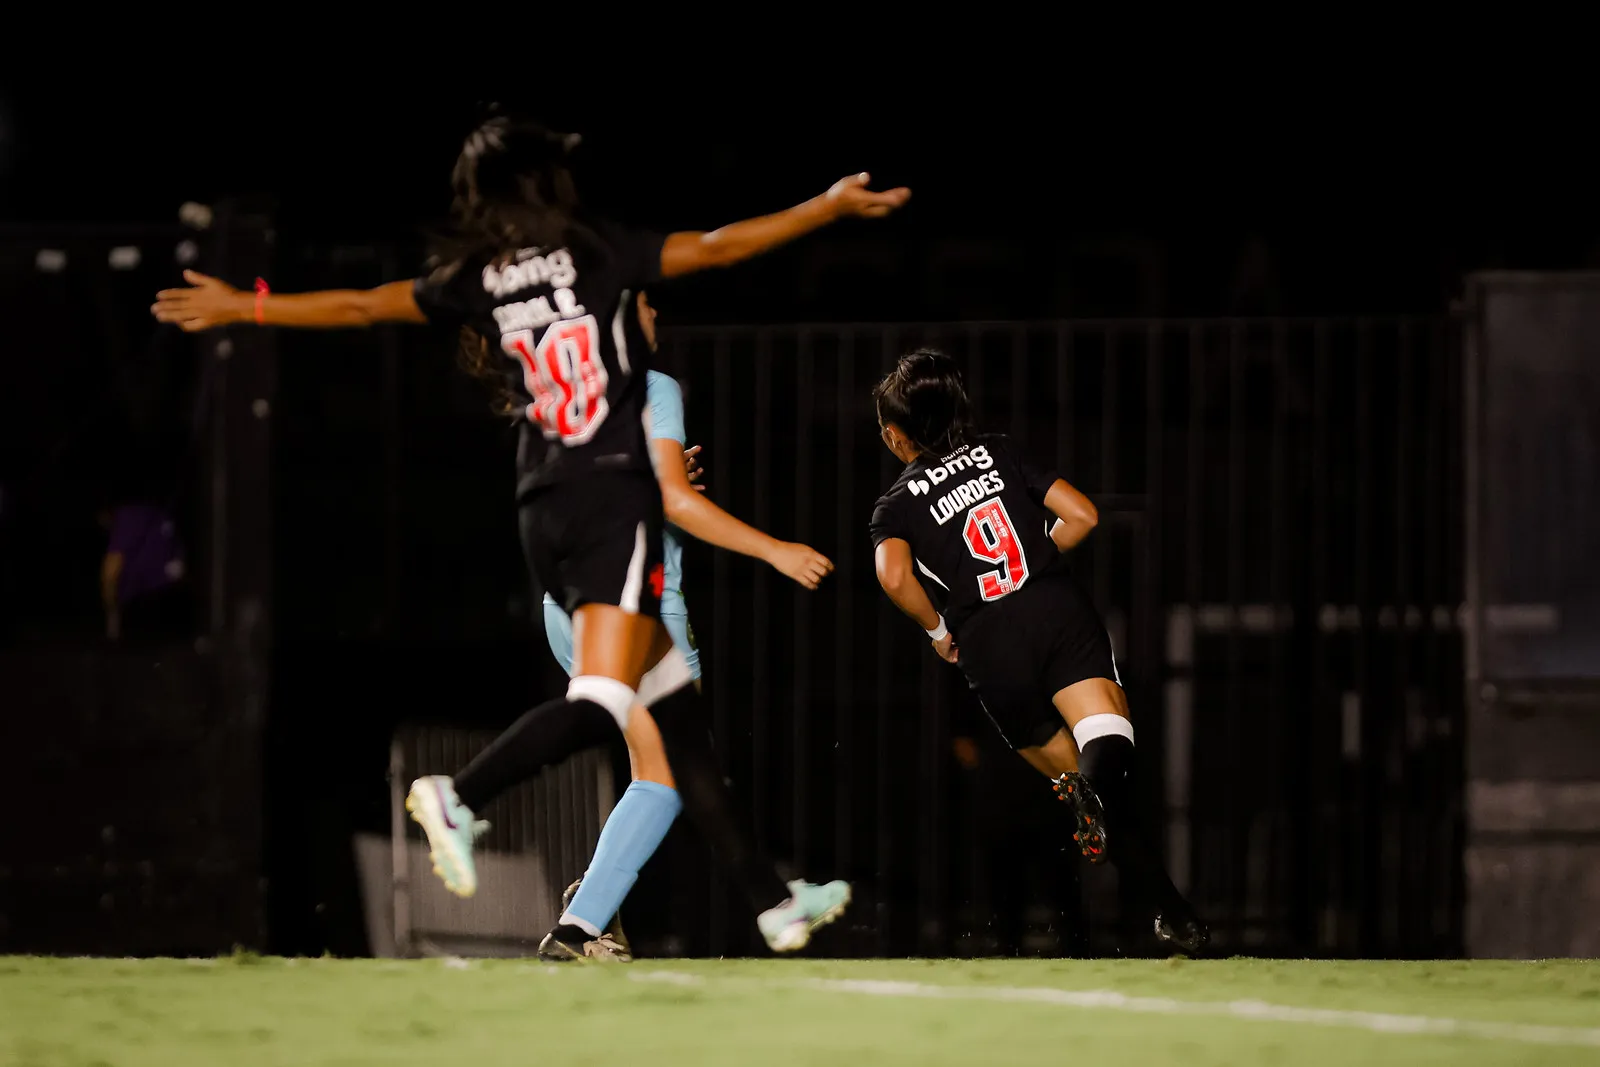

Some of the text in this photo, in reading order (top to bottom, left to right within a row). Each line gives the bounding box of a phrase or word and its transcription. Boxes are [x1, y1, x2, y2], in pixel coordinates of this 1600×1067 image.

[501, 314, 609, 447] 10
[925, 445, 994, 486] bmg
[929, 470, 1005, 526] LOURDES
[962, 496, 1030, 602] 9
